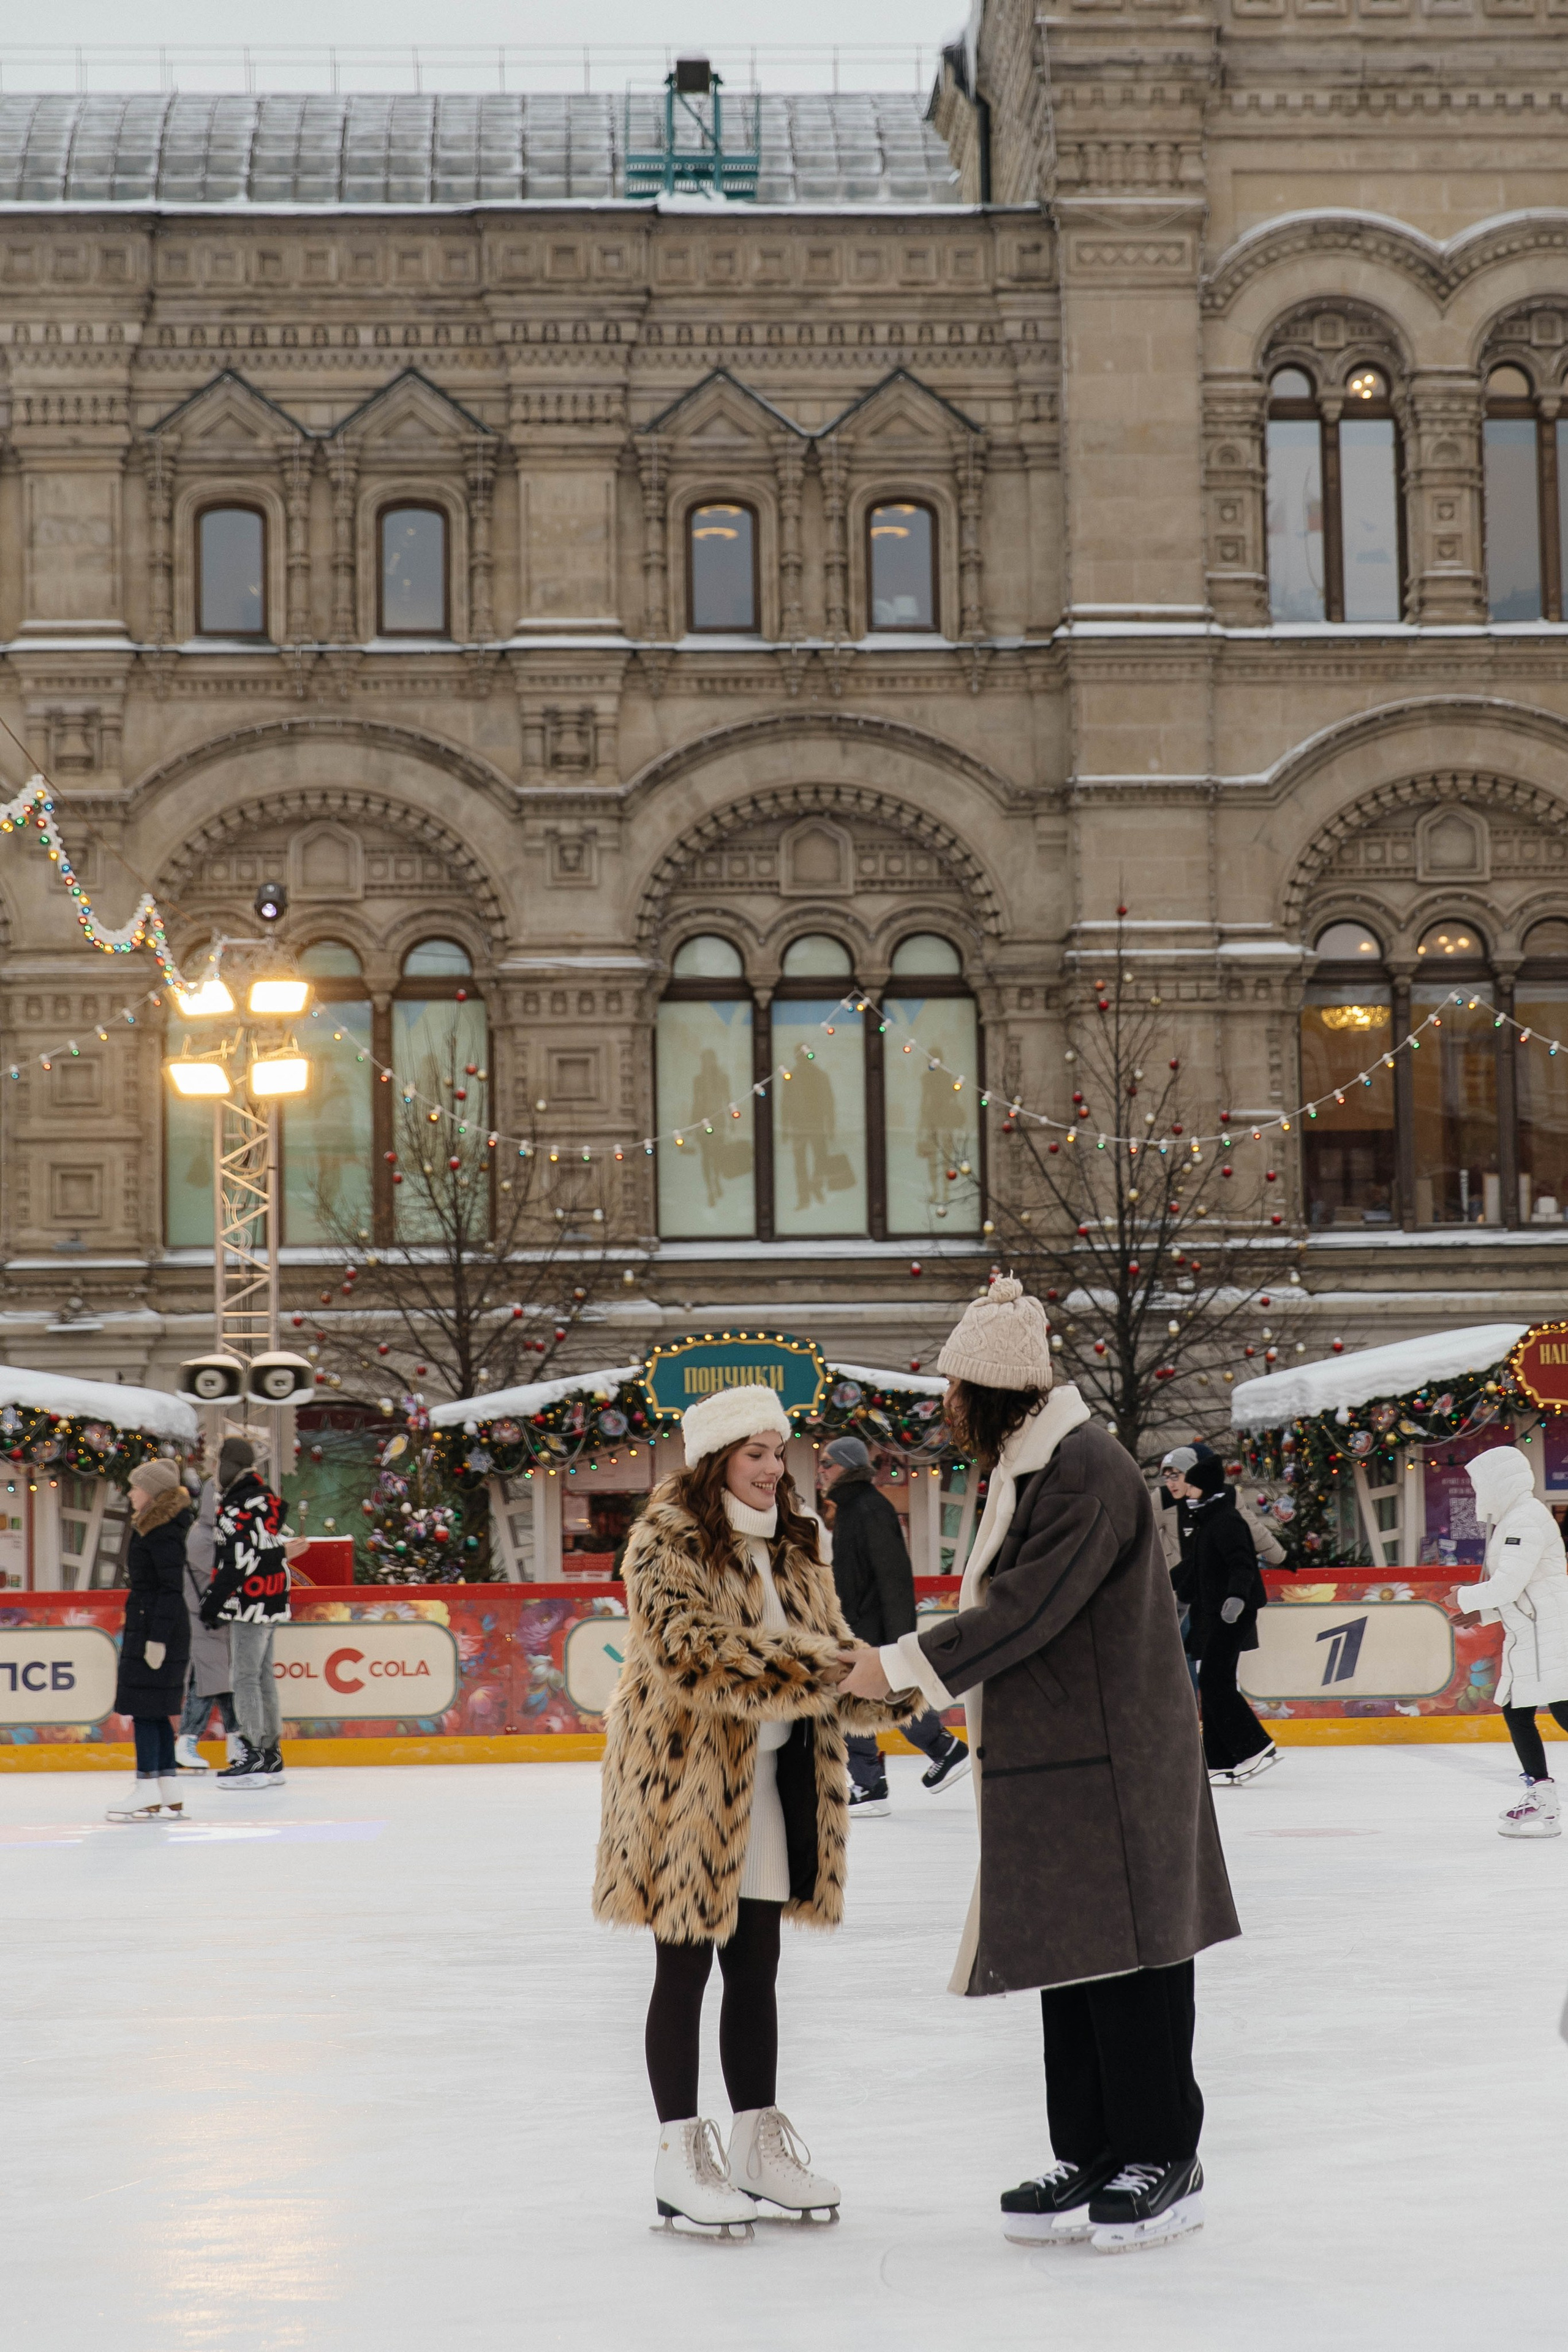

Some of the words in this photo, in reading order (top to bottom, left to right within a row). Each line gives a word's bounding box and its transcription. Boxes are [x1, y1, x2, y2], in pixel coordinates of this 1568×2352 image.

[684, 1365, 784, 1393] ПОНЧИКИ
[273, 1662, 318, 1679] OOL
[369, 1660, 431, 1677] COLA
